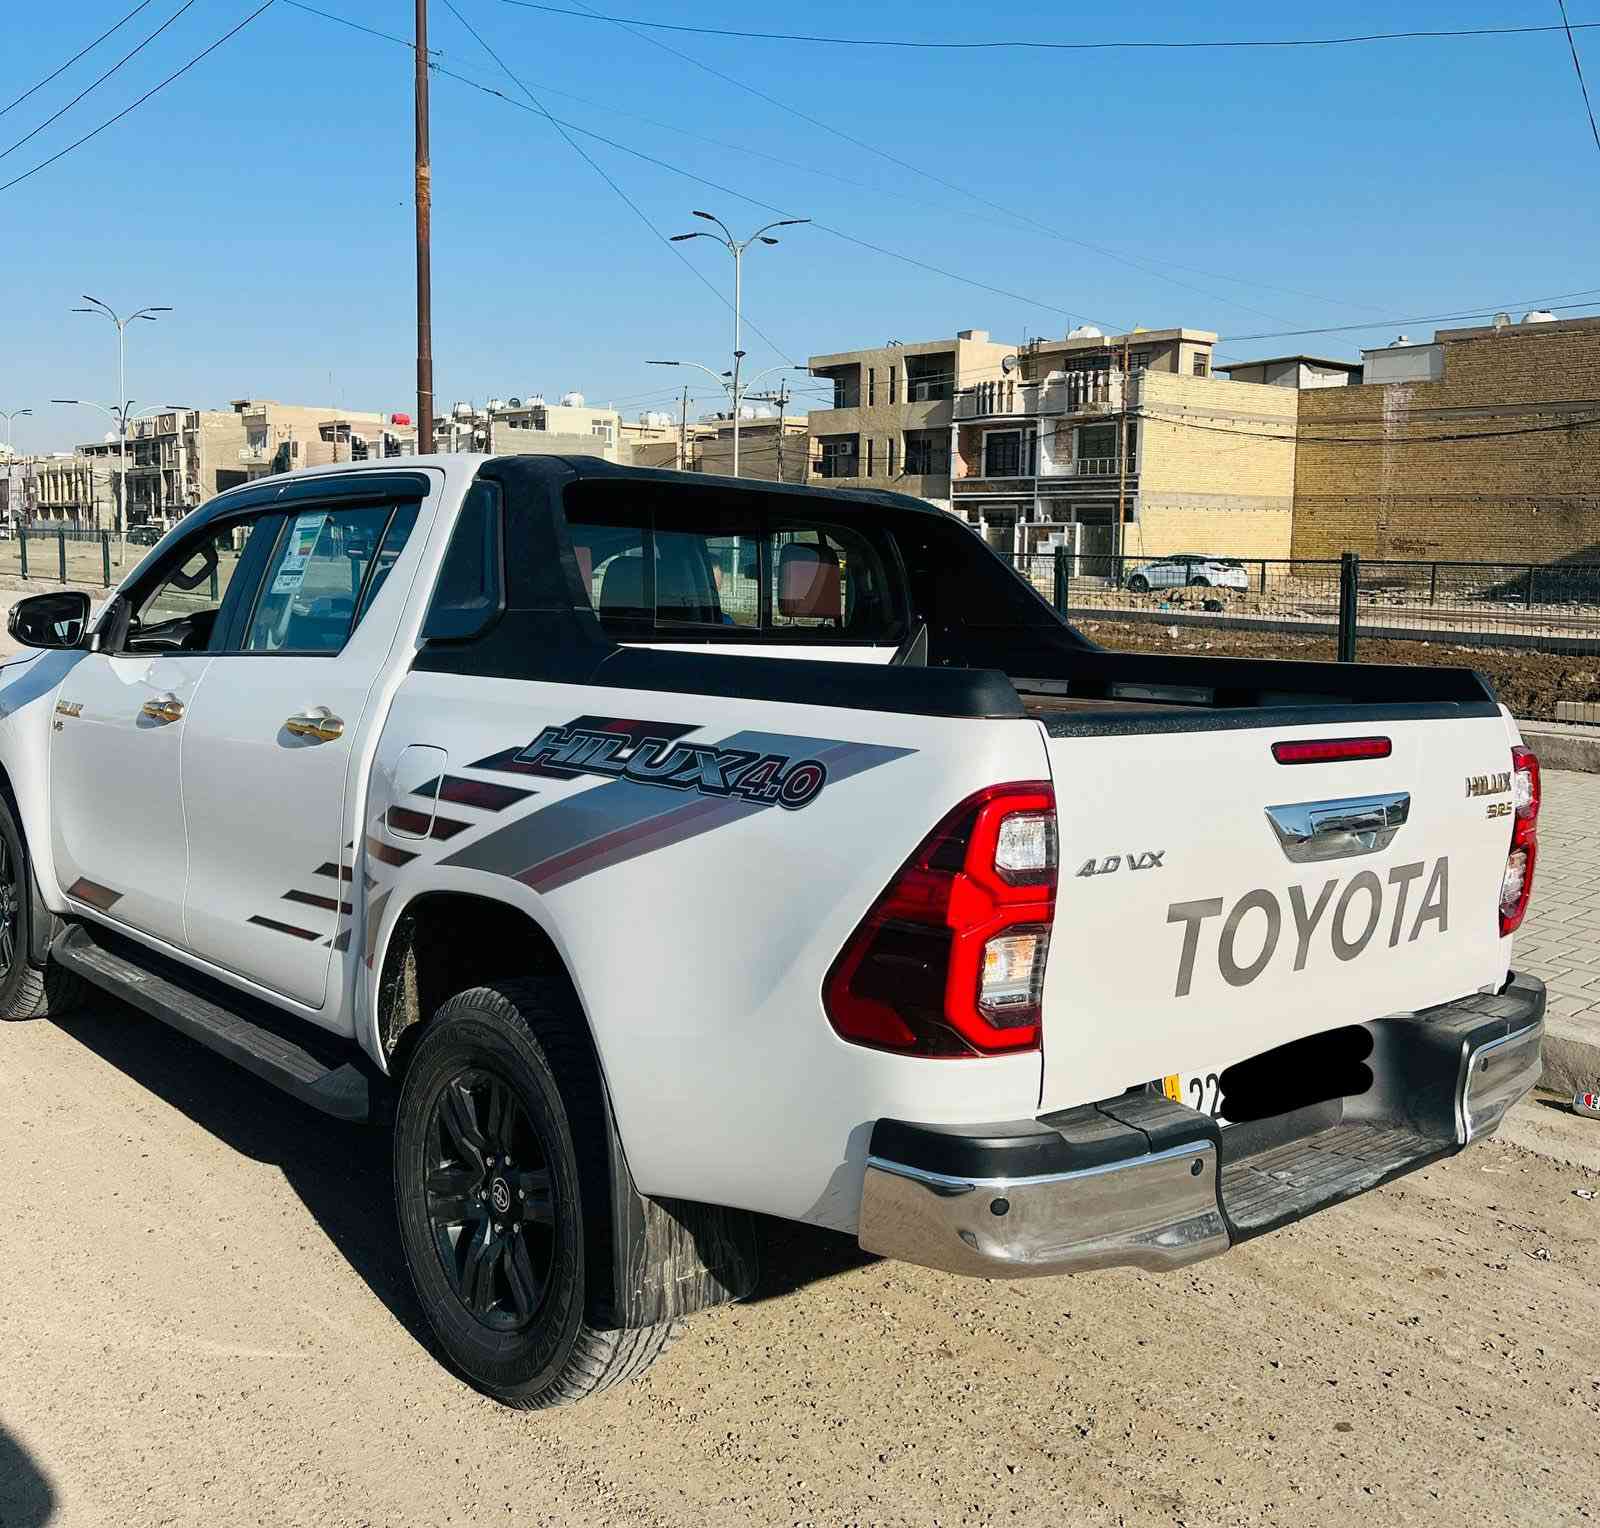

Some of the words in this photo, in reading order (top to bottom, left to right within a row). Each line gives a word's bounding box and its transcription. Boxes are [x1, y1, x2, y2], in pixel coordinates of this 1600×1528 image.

[1464, 771, 1512, 797] HILUX
[1126, 849, 1166, 871] VX
[1166, 855, 1449, 998] TOYOTA
